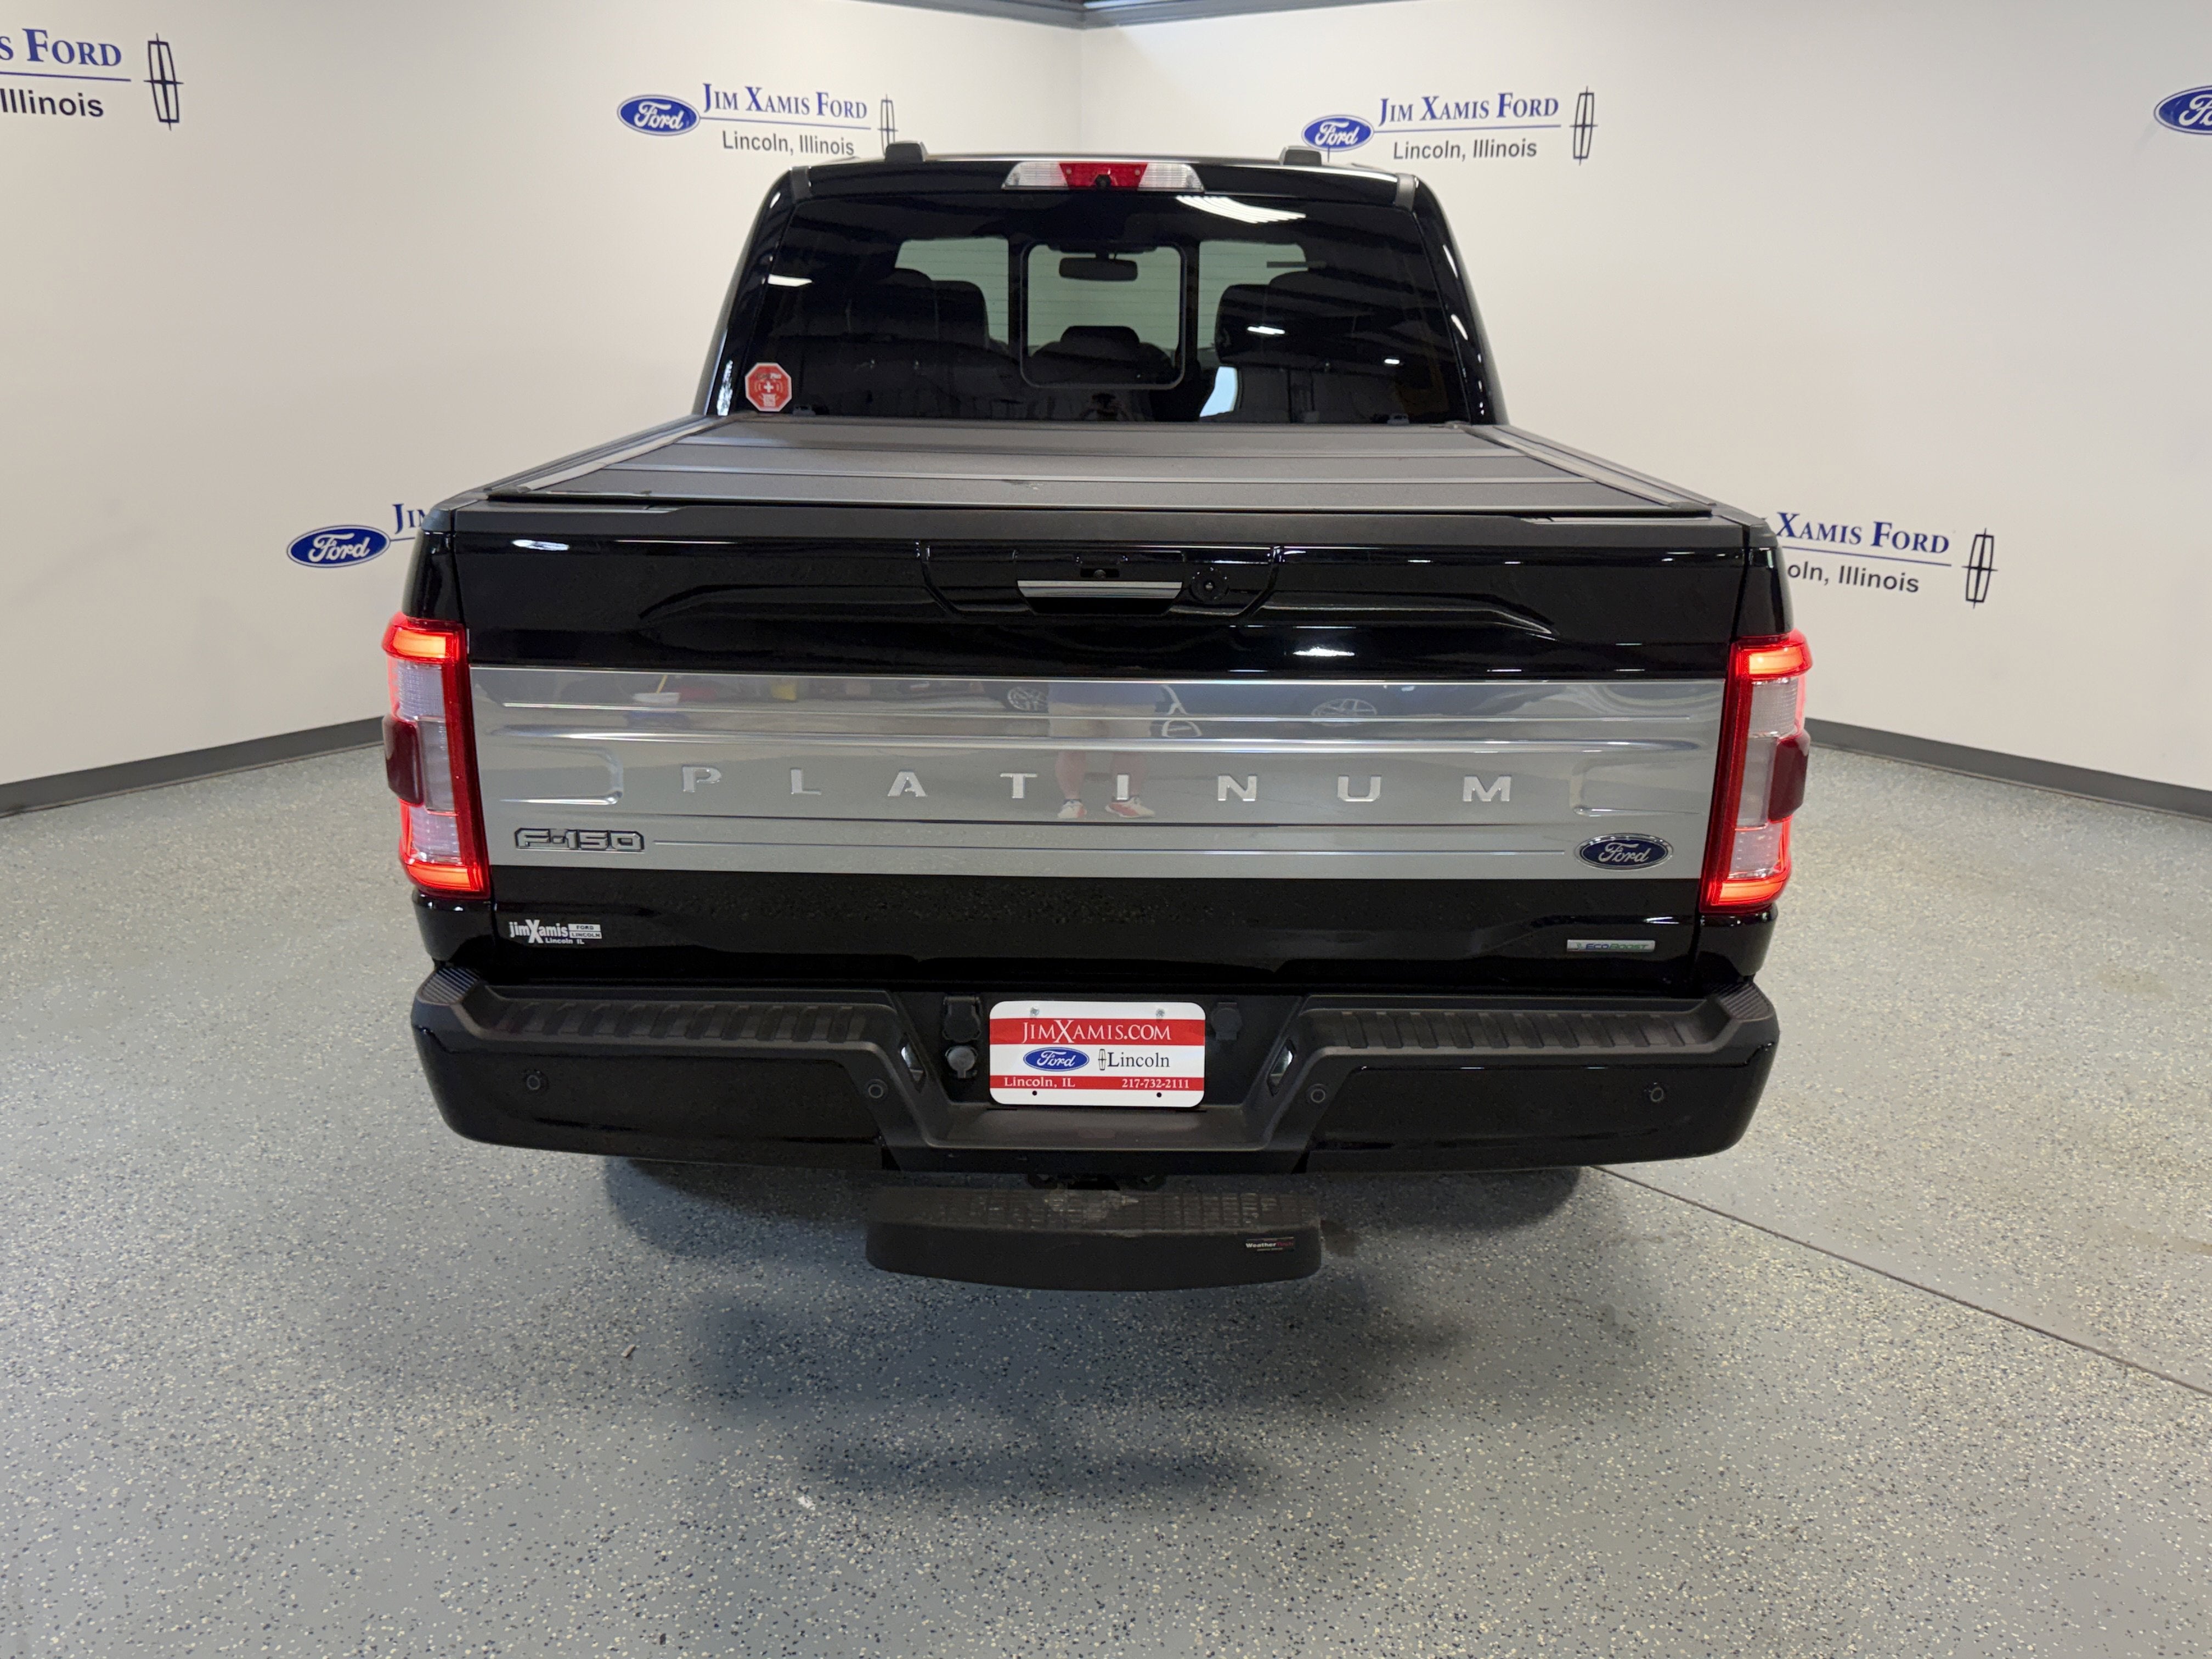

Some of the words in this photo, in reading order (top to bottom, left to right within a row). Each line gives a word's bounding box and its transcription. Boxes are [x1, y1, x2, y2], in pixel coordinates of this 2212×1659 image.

[21, 28, 122, 66] FORD
[703, 83, 739, 113] JIM
[744, 86, 810, 115] XAMIS
[816, 92, 868, 119] FORD
[1378, 98, 1413, 127] JIM
[1419, 96, 1489, 121] XAMIS
[1497, 92, 1559, 119] FORD
[634, 101, 684, 130] Ford
[722, 130, 794, 156] Lincoln,
[799, 134, 854, 156] Illinois
[1314, 121, 1360, 145] Ford
[1393, 141, 1466, 161] Lincoln,
[1472, 139, 1537, 158] Illinois
[1776, 512, 1863, 545] XAMIS
[1870, 521, 1950, 554] FORD
[308, 533, 371, 562] Ford
[1838, 566, 1919, 593] Illinois
[682, 766, 1512, 803] PLATINUM
[515, 827, 645, 854] F-150
[1598, 842, 1651, 862] Ford
[1022, 1019, 1172, 1044] JIMXAMIS.COM
[1036, 1050, 1076, 1068] Ford
[1107, 1052, 1171, 1068] Lincoln
[1004, 1077, 1057, 1088] Lincoln,
[1062, 1077, 1076, 1088] IL
[1121, 1078, 1190, 1089] 217-732-2111
